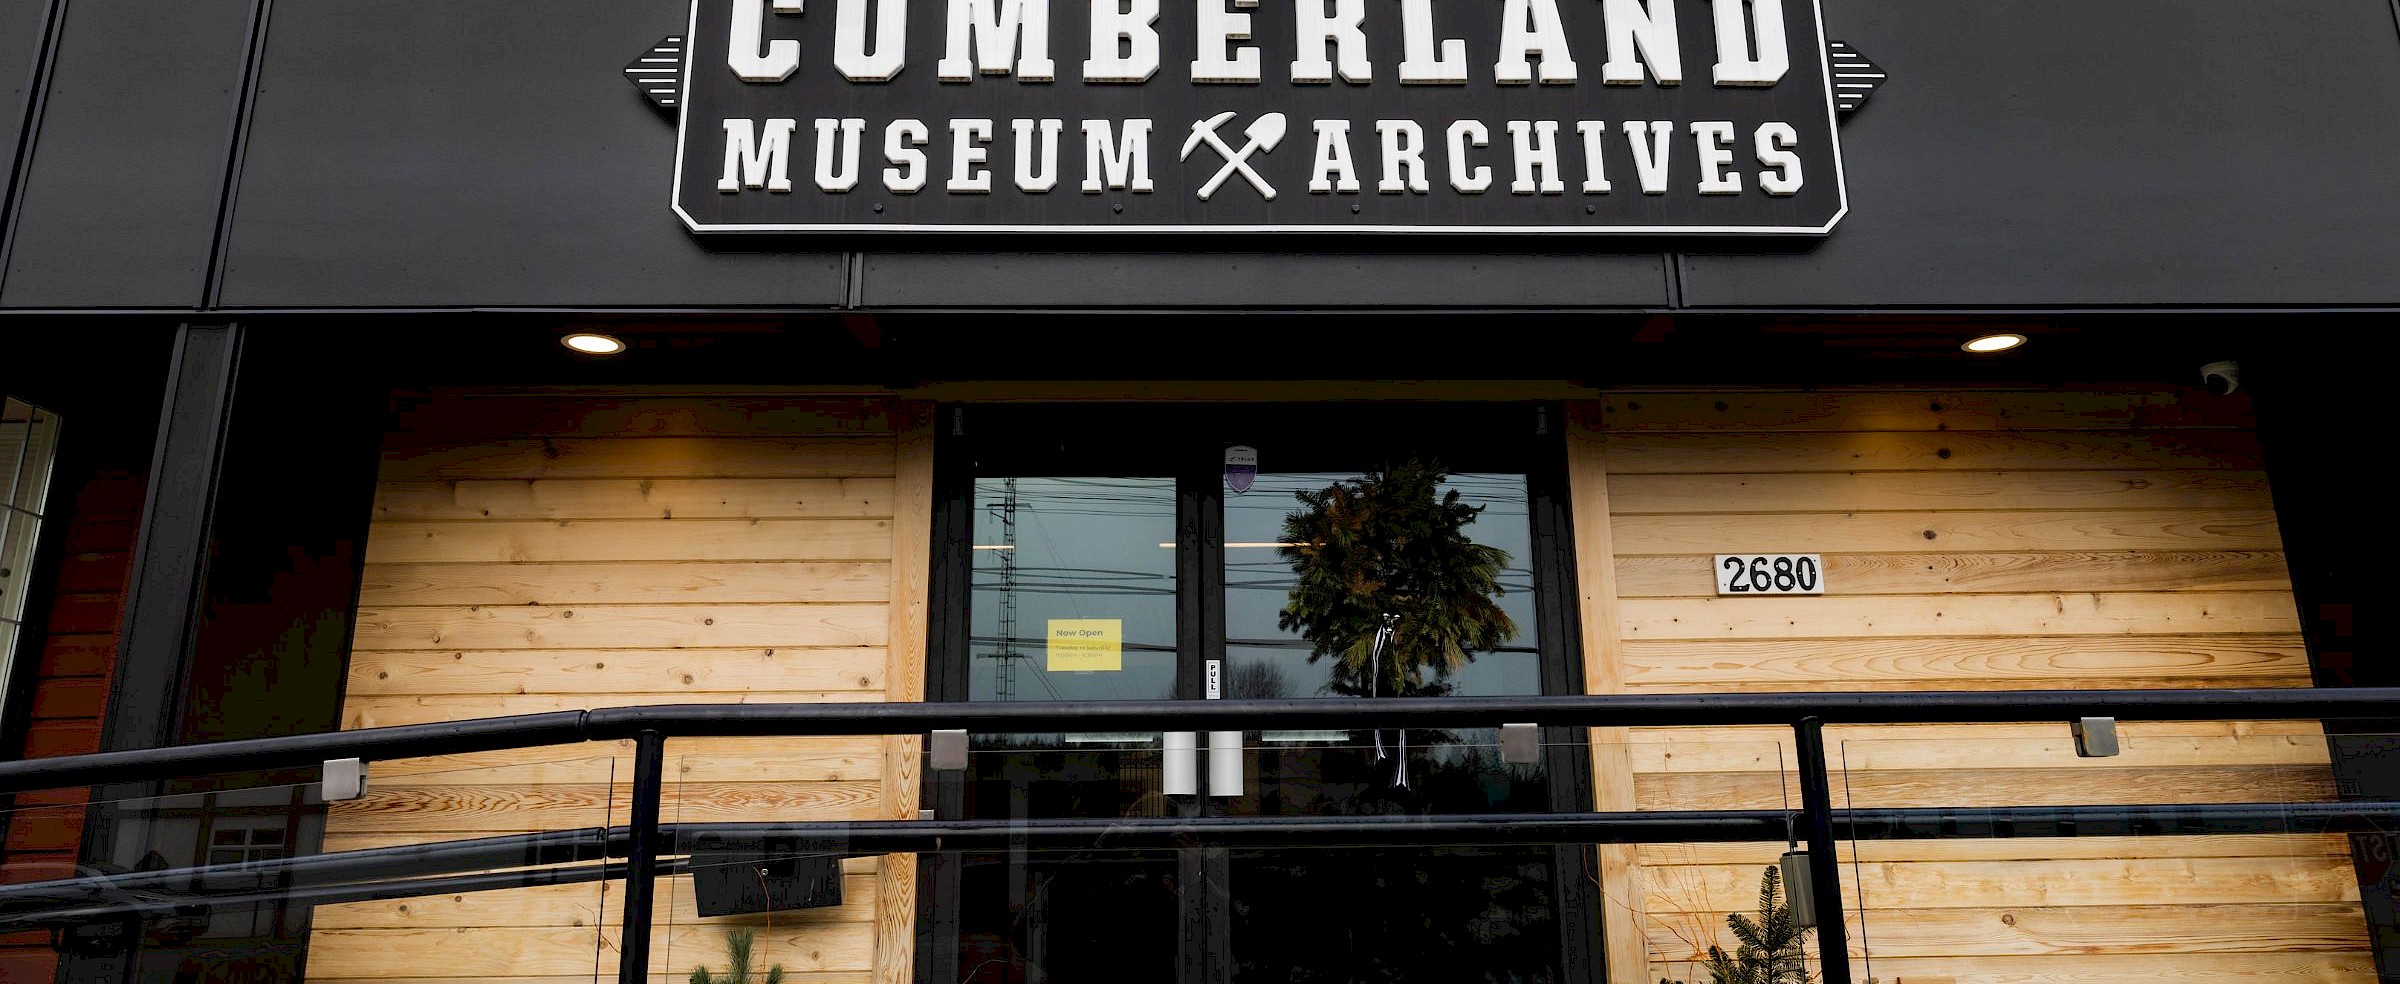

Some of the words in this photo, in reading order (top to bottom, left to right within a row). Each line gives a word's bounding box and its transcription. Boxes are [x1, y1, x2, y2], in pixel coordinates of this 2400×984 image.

[727, 0, 1791, 85] CUMBERLAND
[717, 118, 1154, 194] MUSEUM
[1308, 119, 1804, 196] ARCHIVES
[1723, 556, 1817, 592] 2680
[1056, 629, 1077, 637] Now
[1079, 629, 1104, 638] Open
